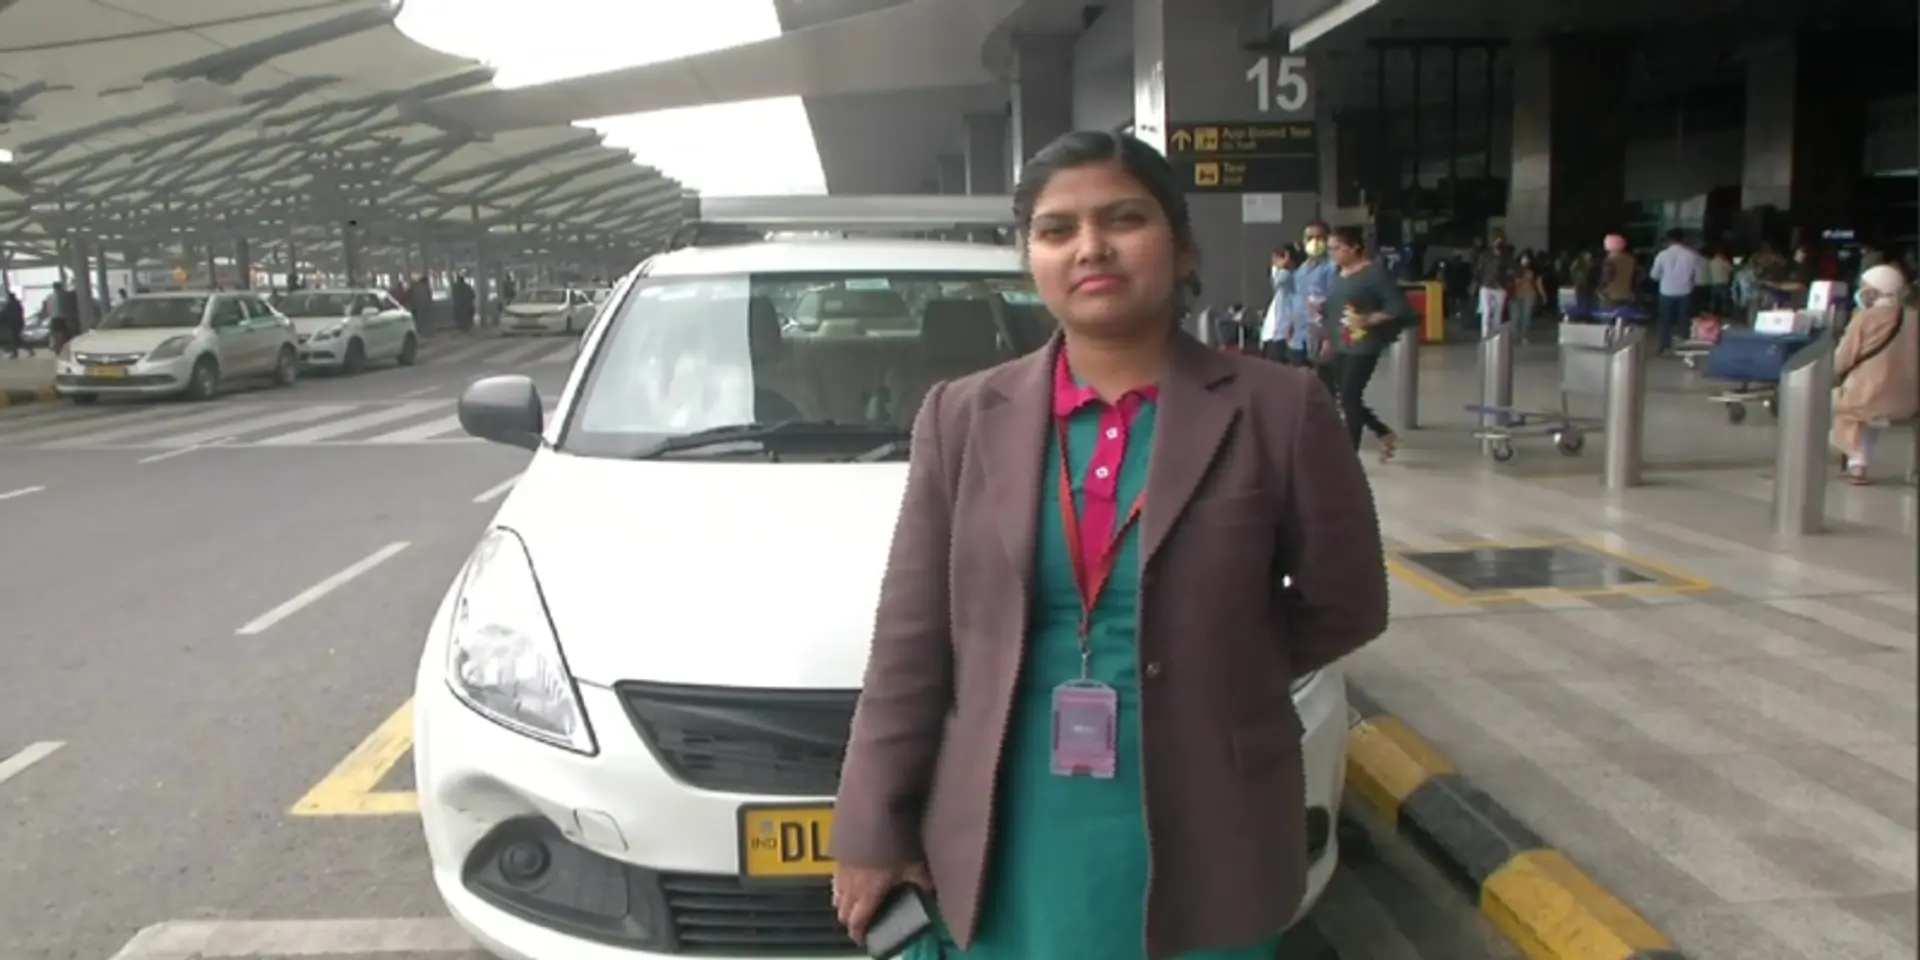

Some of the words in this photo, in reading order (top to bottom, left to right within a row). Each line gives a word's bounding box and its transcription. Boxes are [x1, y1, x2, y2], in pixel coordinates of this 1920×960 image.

[1246, 56, 1308, 112] 15
[1222, 126, 1245, 140] App
[750, 836, 778, 850] IND
